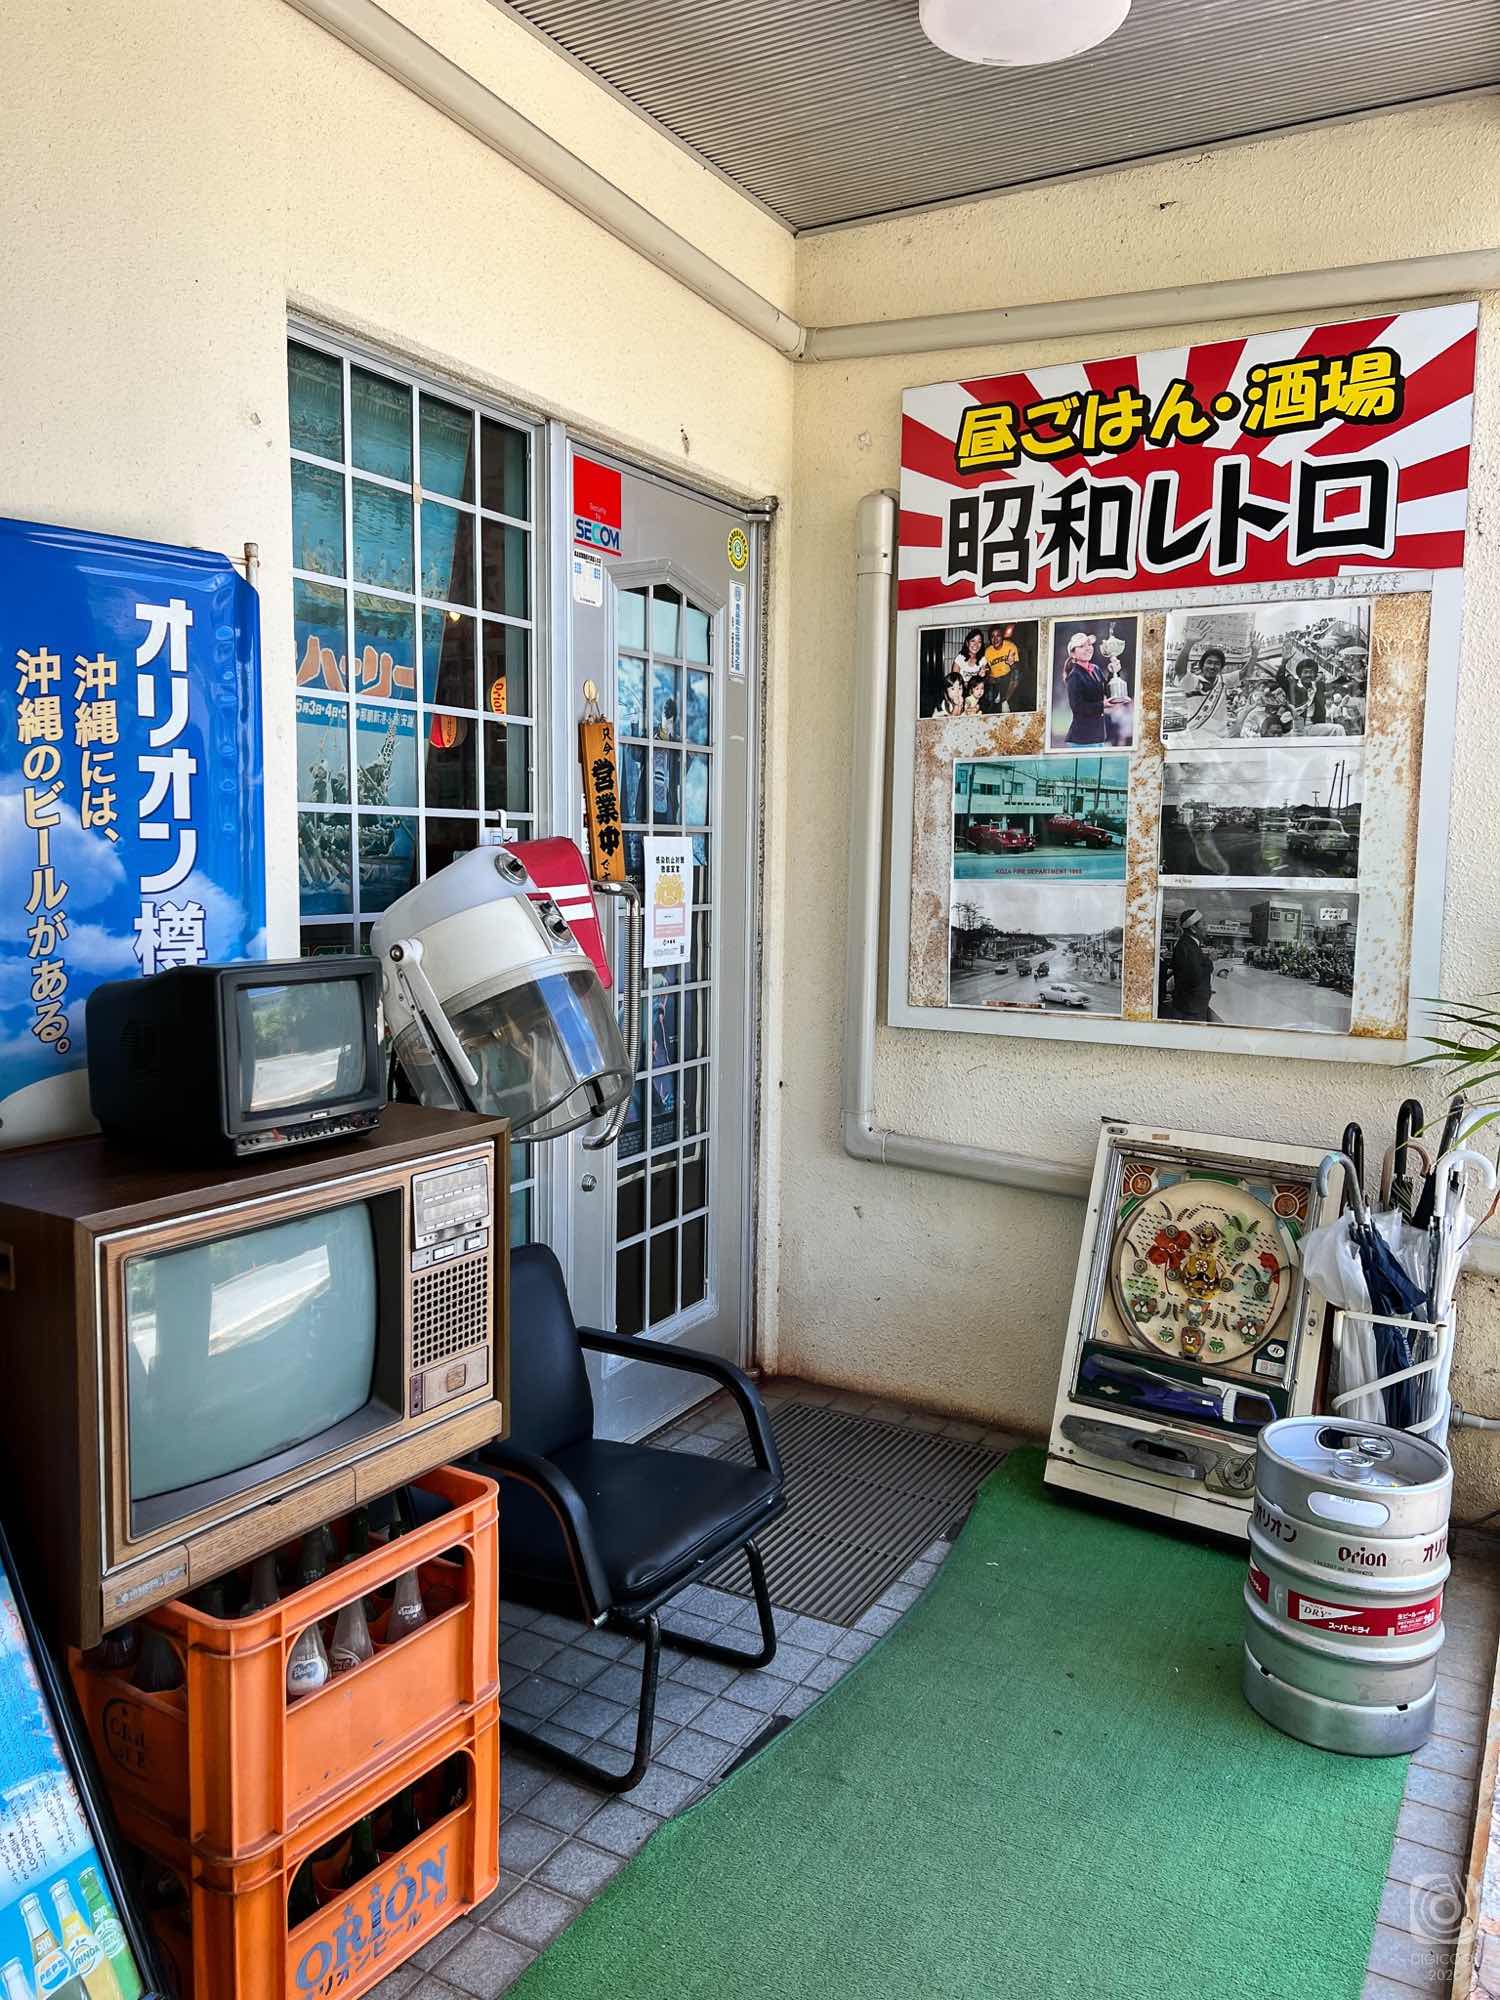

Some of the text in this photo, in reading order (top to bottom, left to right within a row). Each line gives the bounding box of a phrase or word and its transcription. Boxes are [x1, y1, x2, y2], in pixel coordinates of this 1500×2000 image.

[958, 348, 1400, 471] 昼ごはん・酒場
[575, 518, 620, 550] SECOM
[947, 459, 1396, 590] 昭和レトロ
[73, 652, 120, 844] 沖縄には、
[14, 647, 71, 1055] 沖縄のビールがある。
[1255, 1503, 1297, 1543] オリオン
[1338, 1545, 1387, 1568] Orion
[1328, 1621, 1371, 1634] スーパードライ
[295, 1840, 449, 1990] ORION
